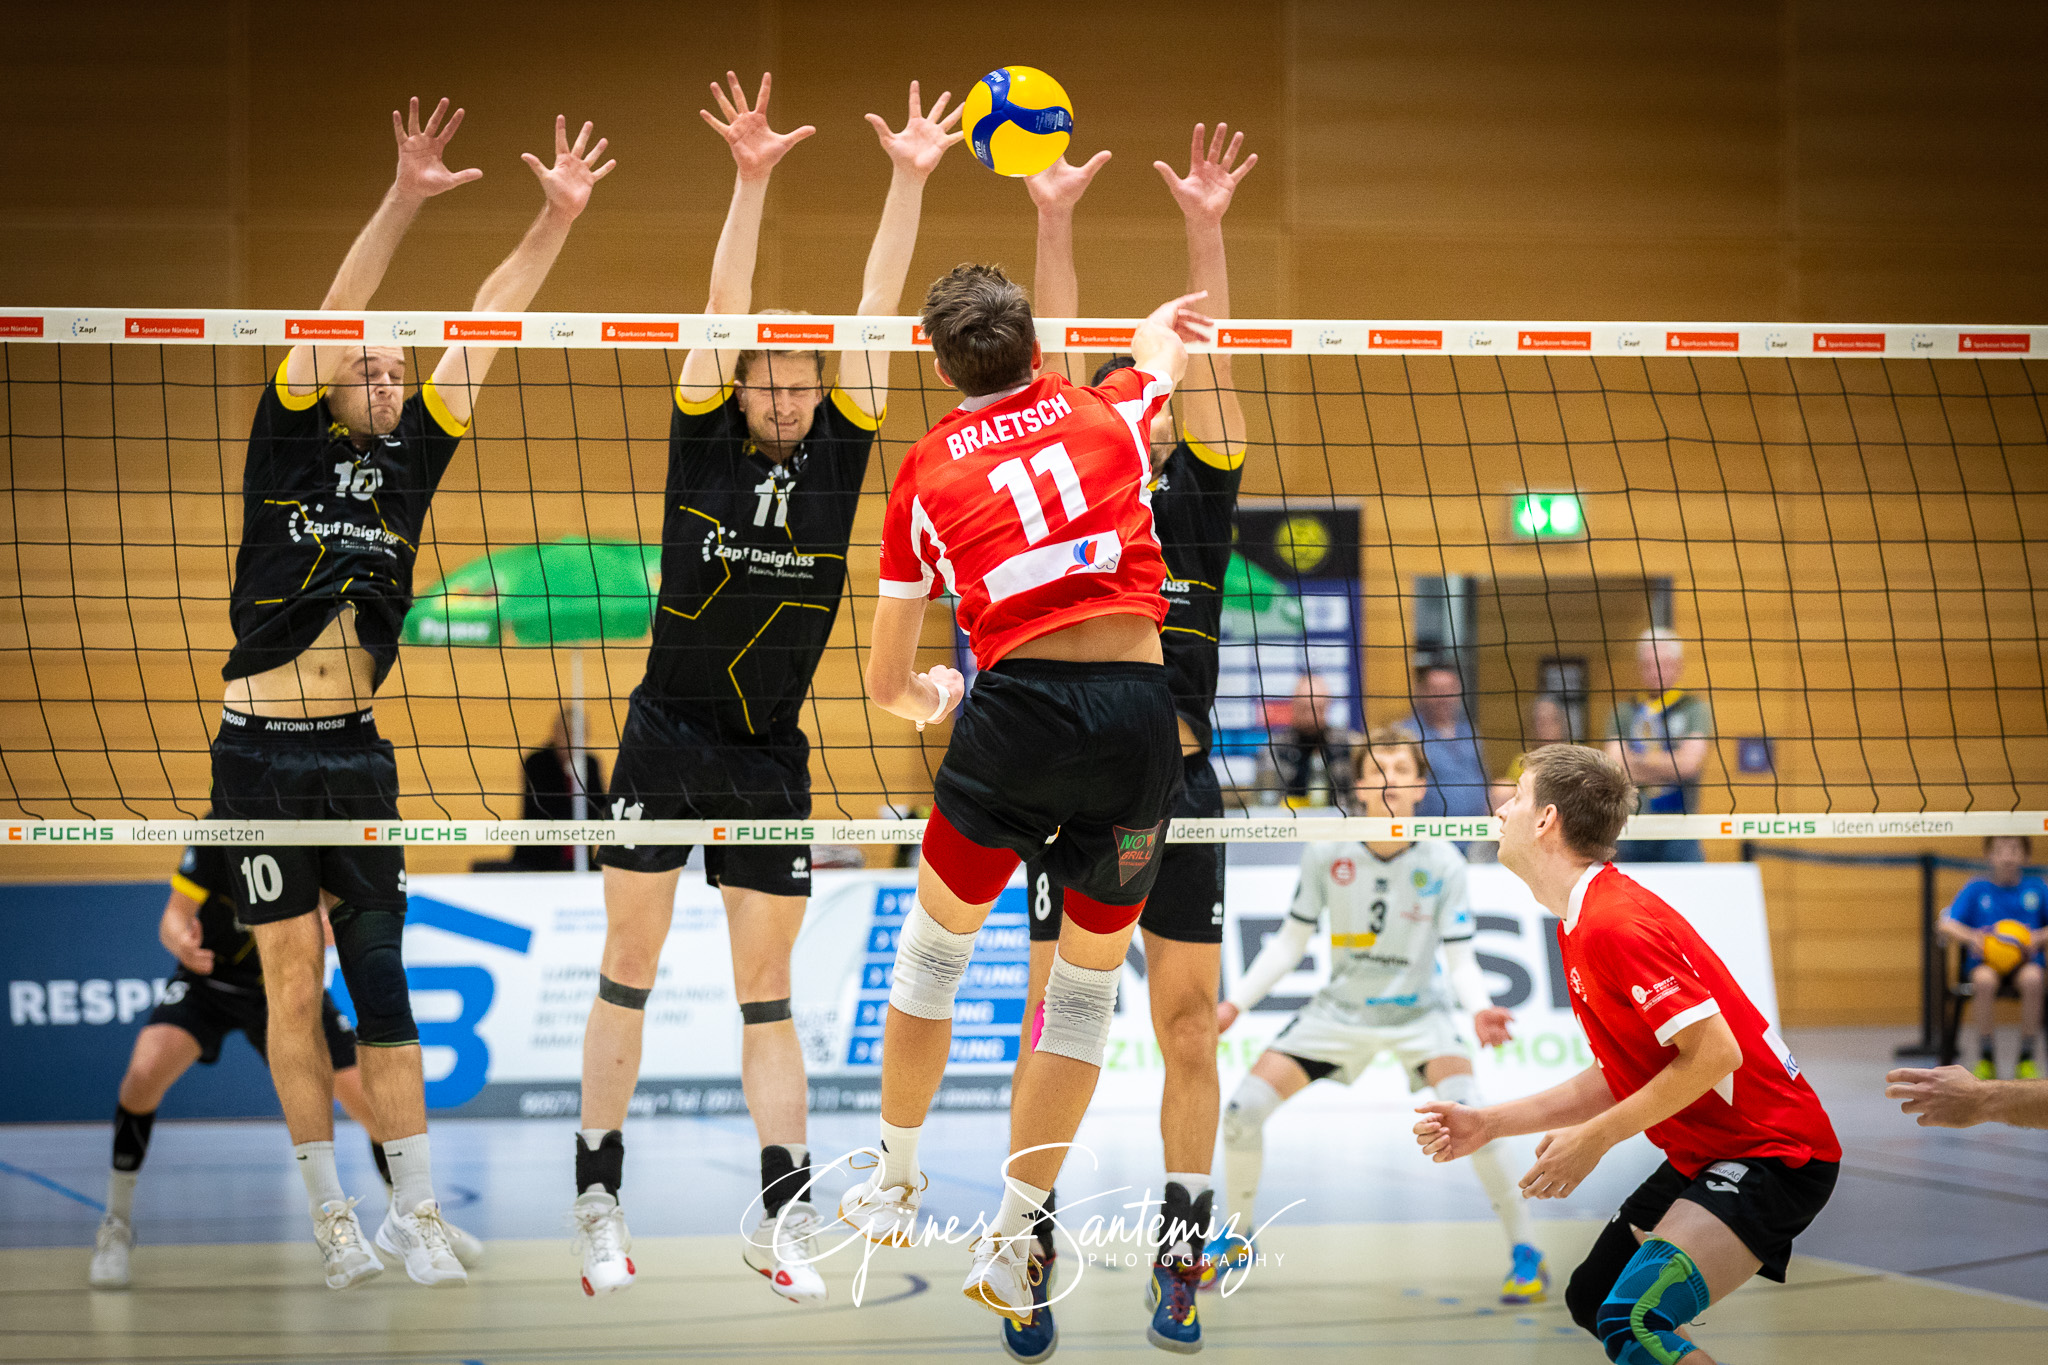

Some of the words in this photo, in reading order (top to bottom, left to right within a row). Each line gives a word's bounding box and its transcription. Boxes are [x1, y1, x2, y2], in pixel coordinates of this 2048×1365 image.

[79, 325, 97, 334] Zapf
[141, 326, 172, 335] Sparkasse
[173, 326, 200, 335] Nürnberg
[240, 327, 257, 336] Zapf
[301, 327, 331, 336] Sparkasse
[332, 328, 359, 337] Nürnberg
[399, 329, 416, 338] Zapf
[460, 328, 488, 337] Sparkasse
[557, 330, 574, 338] Zapf
[617, 330, 646, 338] Sparkasse
[713, 331, 730, 340] Zapf
[773, 331, 801, 340] Sparkasse
[868, 332, 885, 341] Zapf
[1325, 338, 1342, 346] Zapf
[1475, 339, 1492, 347] Zapf
[946, 393, 1072, 461] BRAETSCH
[334, 460, 383, 501] 10
[987, 441, 1089, 546] 11
[753, 479, 796, 527] 11
[226, 711, 247, 727] ROSSI
[265, 720, 313, 732] ANTONIO
[316, 718, 346, 731] ROSSI
[1172, 824, 1214, 839] Ideen
[1220, 824, 1298, 839] umsetzen
[1414, 823, 1488, 837] FUCHS
[1743, 821, 1816, 834] FUCHS
[1832, 820, 1873, 834] Ideen
[1879, 819, 1953, 834] umsetzen
[33, 827, 114, 841] FUCHS
[132, 827, 177, 841] Ideen
[183, 827, 264, 842] umsetzen
[388, 827, 467, 841] FUCHS
[486, 827, 529, 841] Ideen
[535, 827, 615, 842] umsetzen
[737, 827, 814, 840] FUCHS
[832, 827, 875, 841] Ideen
[882, 829, 925, 841] umse
[1121, 851, 1150, 860] GRILL
[240, 854, 284, 905] 10
[1034, 872, 1052, 921] 8
[1369, 899, 1388, 934] 3
